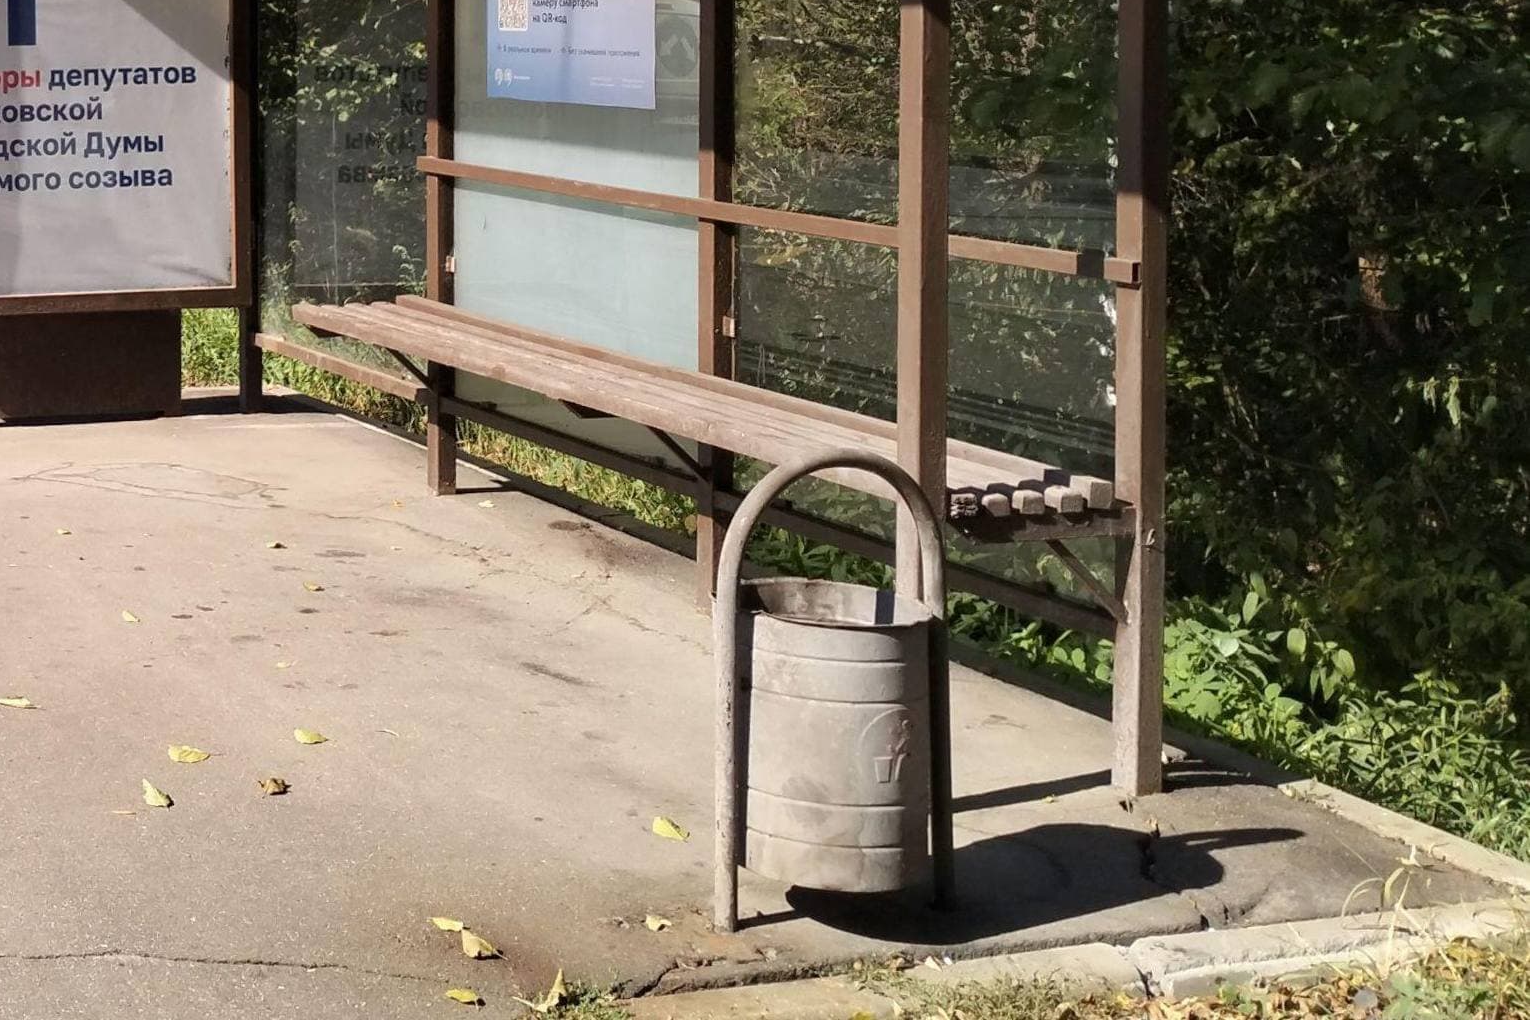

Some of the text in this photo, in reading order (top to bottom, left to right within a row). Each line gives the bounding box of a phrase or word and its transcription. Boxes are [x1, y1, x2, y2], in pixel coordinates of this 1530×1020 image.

[48, 65, 197, 92] депутатов
[83, 131, 164, 160] Думы
[68, 167, 173, 190] созыва
